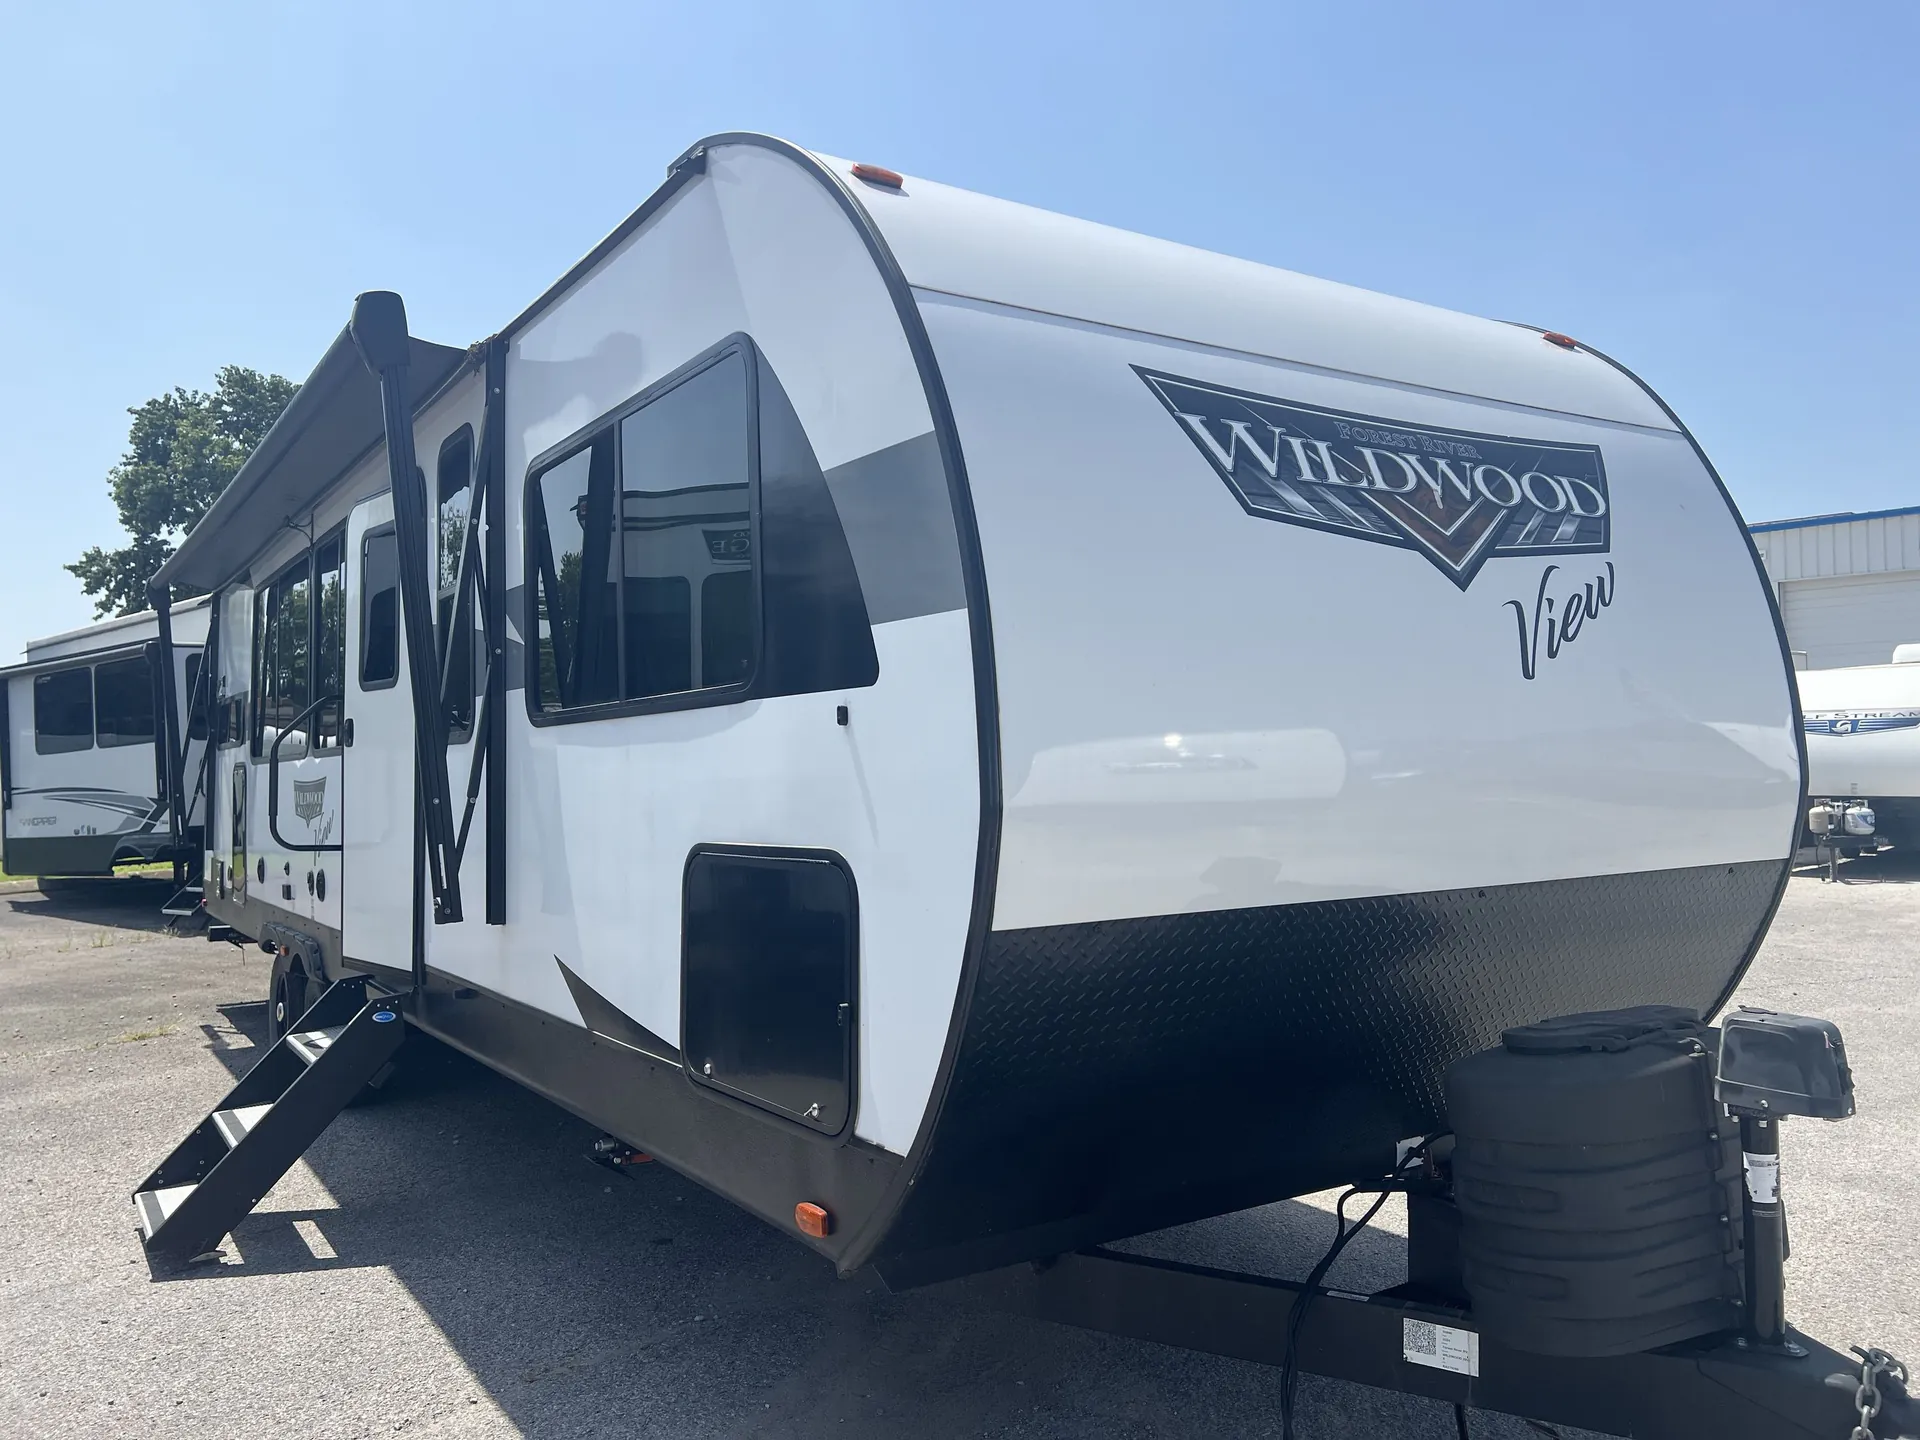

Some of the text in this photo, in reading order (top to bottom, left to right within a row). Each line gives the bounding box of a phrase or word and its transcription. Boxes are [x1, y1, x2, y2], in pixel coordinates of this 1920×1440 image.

[1174, 411, 1607, 518] WILDWOOD
[1333, 421, 1483, 460] FOREST RIVER
[1502, 561, 1615, 680] View
